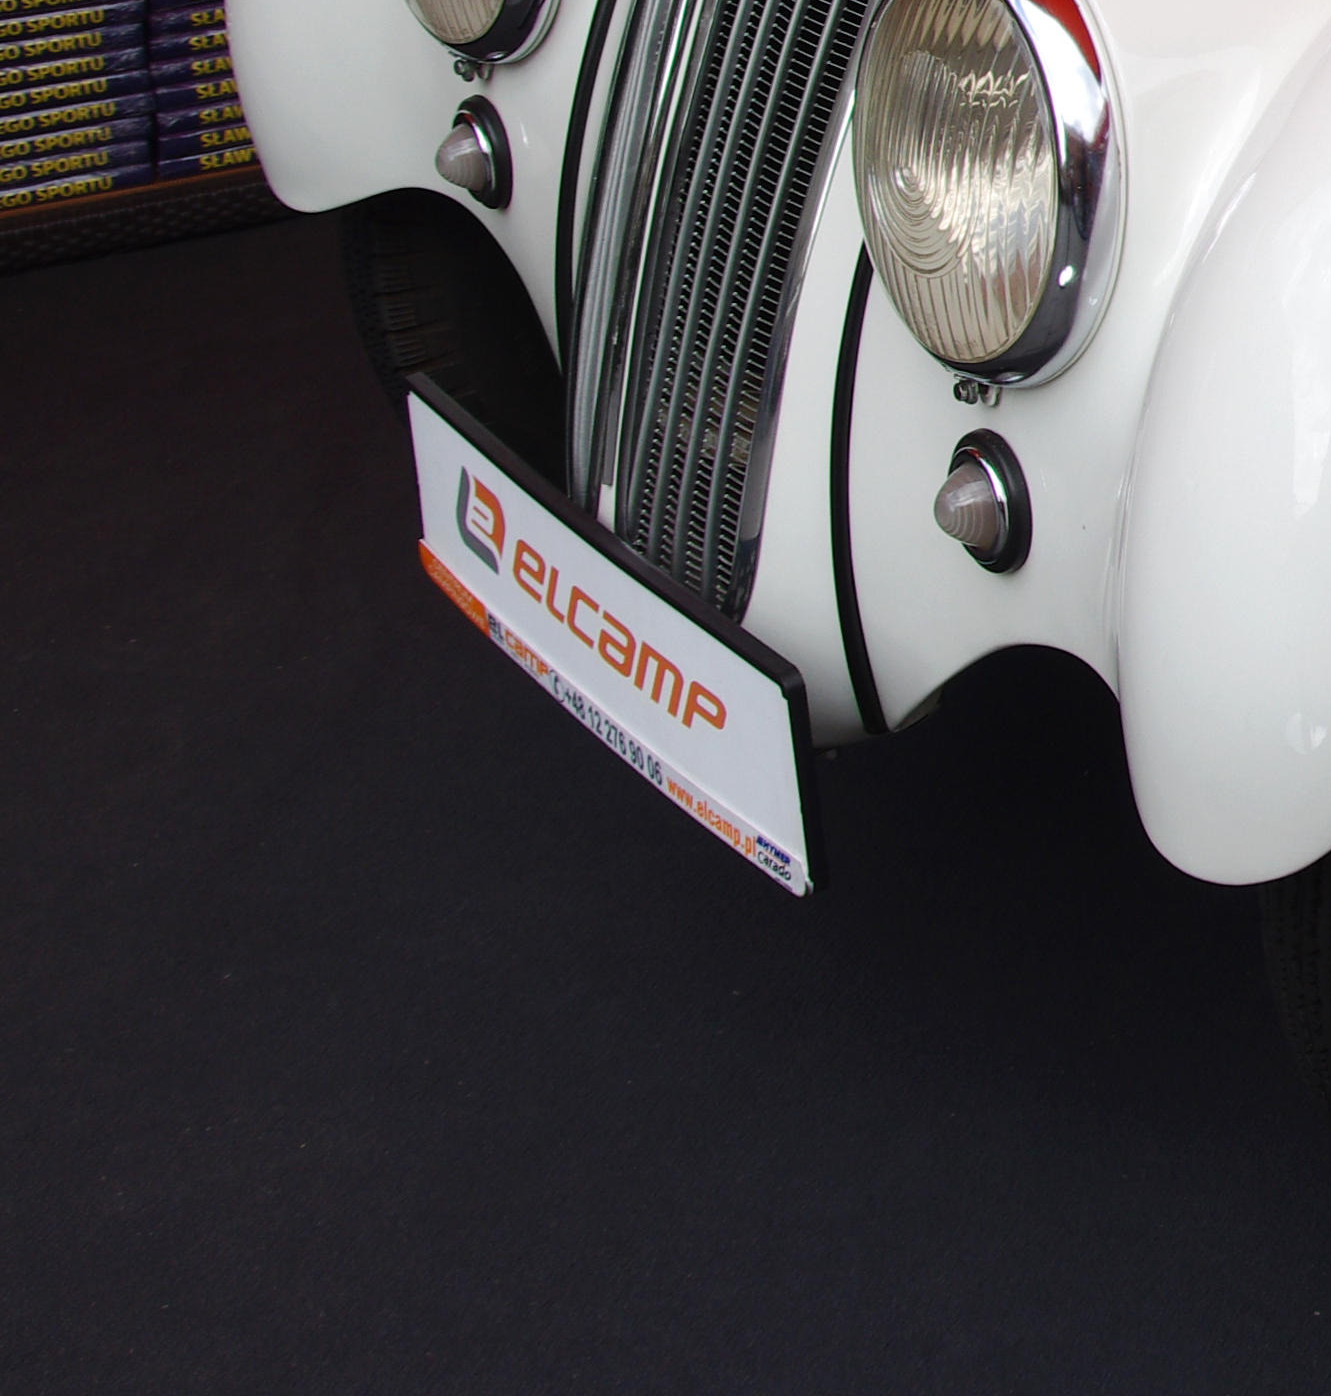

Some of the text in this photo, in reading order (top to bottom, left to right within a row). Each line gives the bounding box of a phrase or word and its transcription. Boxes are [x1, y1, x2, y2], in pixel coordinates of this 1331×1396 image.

[26, 9, 104, 33] SPORTU
[24, 31, 102, 58] SPORTU
[26, 56, 104, 81] SPORTU
[29, 77, 108, 104] SPORTU
[38, 101, 116, 128] SPORTU
[199, 106, 243, 124] SŁAW
[34, 125, 112, 153] SPORTU
[200, 127, 251, 147] SŁAW
[31, 149, 109, 177] SPORTU
[200, 148, 255, 170] SŁAW
[36, 176, 113, 202] SPORTU
[565, 689, 585, 720] +48
[588, 705, 602, 735] 12
[604, 719, 626, 755] 276
[629, 740, 644, 771] 90
[647, 754, 662, 786] 06
[666, 777, 757, 857] www.elcamp.pl
[757, 851, 792, 881] Carado
